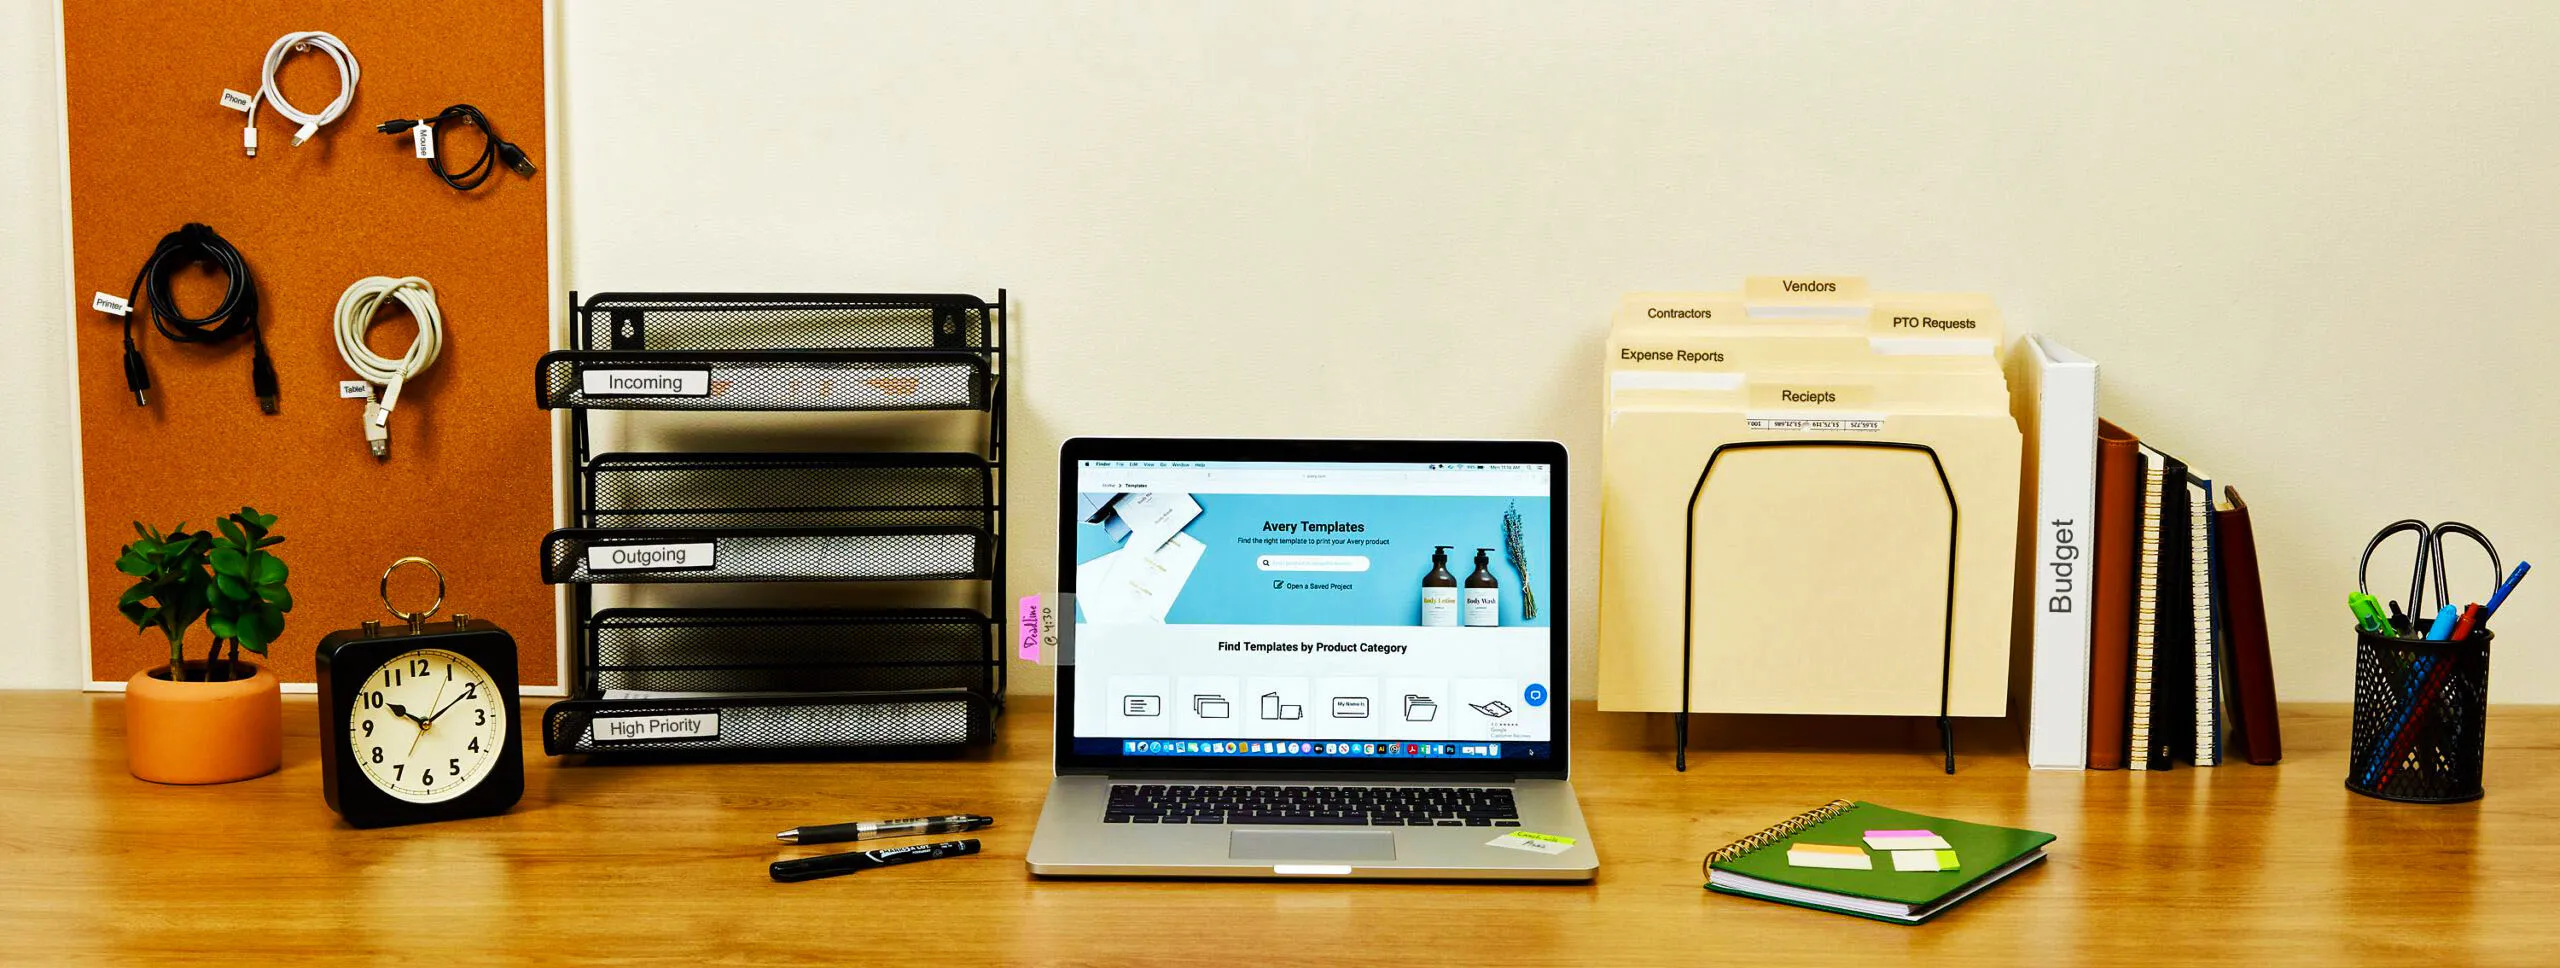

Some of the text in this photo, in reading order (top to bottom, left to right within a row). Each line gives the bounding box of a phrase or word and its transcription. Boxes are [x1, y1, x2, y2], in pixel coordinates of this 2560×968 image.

[224, 93, 247, 106] Phone
[419, 129, 428, 156] Mouse
[1782, 280, 1836, 293] Vendors
[95, 298, 123, 312] Printer
[1647, 308, 1711, 319] Contractors
[1893, 317, 1976, 330] PTO Requests
[1621, 349, 1724, 363] Expense Reports
[343, 384, 366, 394] Tablet
[608, 374, 683, 393] Incoming
[1782, 390, 1836, 403] Reciepts
[1262, 521, 1365, 535] Avery Templates
[1252, 537, 1263, 545] the
[1263, 538, 1278, 546] right
[1279, 538, 1307, 546] template
[1316, 538, 1331, 546] print
[1346, 538, 1364, 546] Avery
[1365, 538, 1390, 546] product
[612, 546, 686, 566] Outgoing
[2049, 518, 2080, 613] Budget
[1286, 583, 1304, 591] Open
[1330, 583, 1353, 592] Project
[1022, 606, 1038, 648] Deadline
[1218, 641, 1408, 655] Find Templates by Product Category
[410, 659, 430, 677] 12
[446, 664, 453, 681] 1
[384, 668, 401, 688] 11
[465, 682, 477, 700] 2
[363, 691, 384, 709] 10
[475, 709, 486, 726] 3
[362, 720, 374, 737] 9
[610, 717, 701, 738] High Priority
[467, 736, 480, 754] 4
[372, 747, 384, 763] 8
[393, 764, 404, 781] 7
[450, 759, 461, 775] 5
[422, 769, 434, 785] 6
